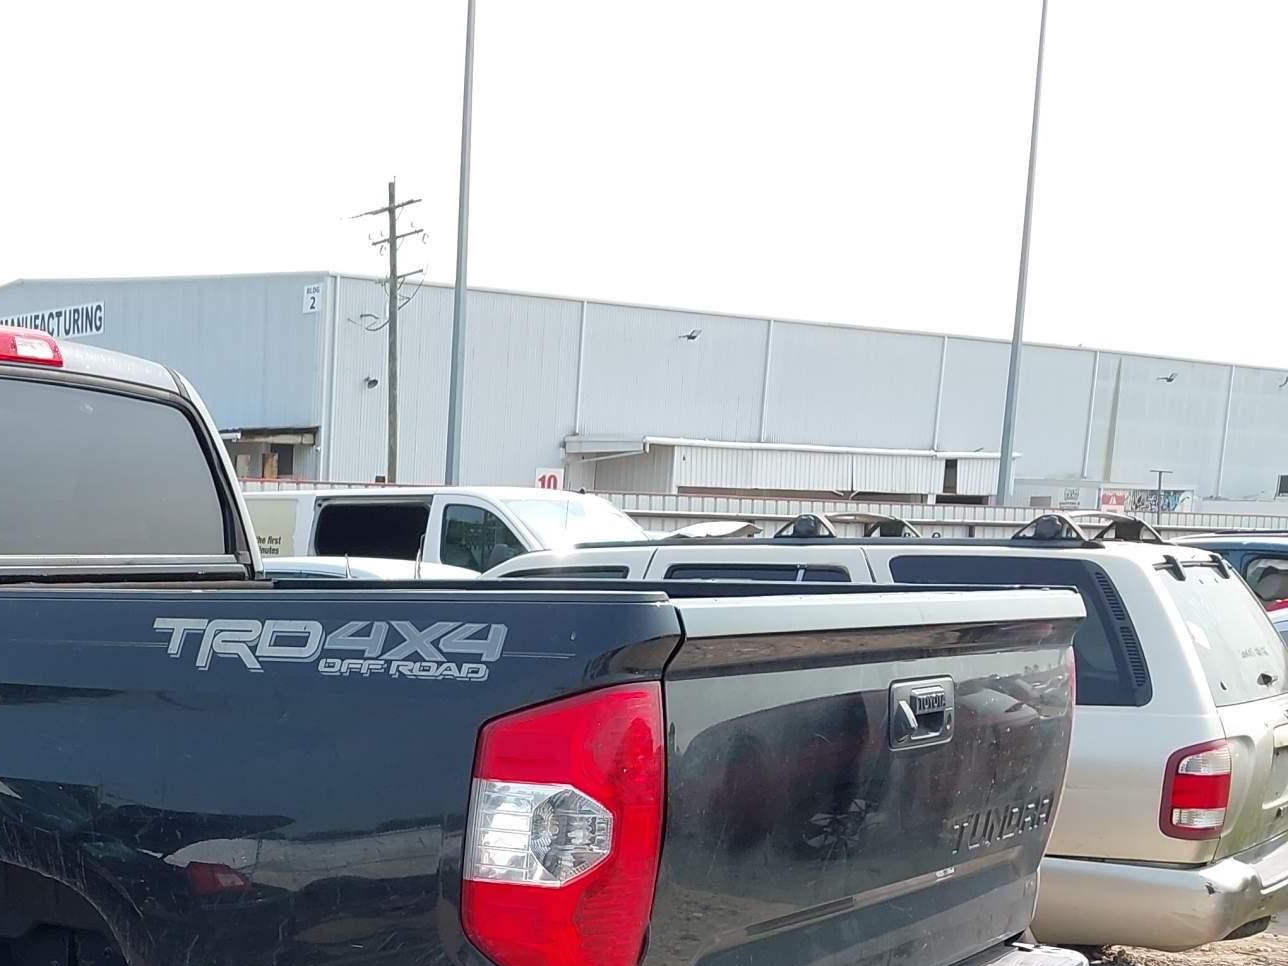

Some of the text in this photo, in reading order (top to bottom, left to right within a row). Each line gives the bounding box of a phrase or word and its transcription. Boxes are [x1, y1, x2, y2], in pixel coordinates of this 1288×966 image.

[310, 296, 316, 310] 2
[267, 535, 282, 545] first
[153, 618, 323, 672] TRD
[318, 658, 491, 682] OFF ROAD
[916, 694, 946, 711] TOYOTA
[951, 793, 1054, 854] TUNDRA
